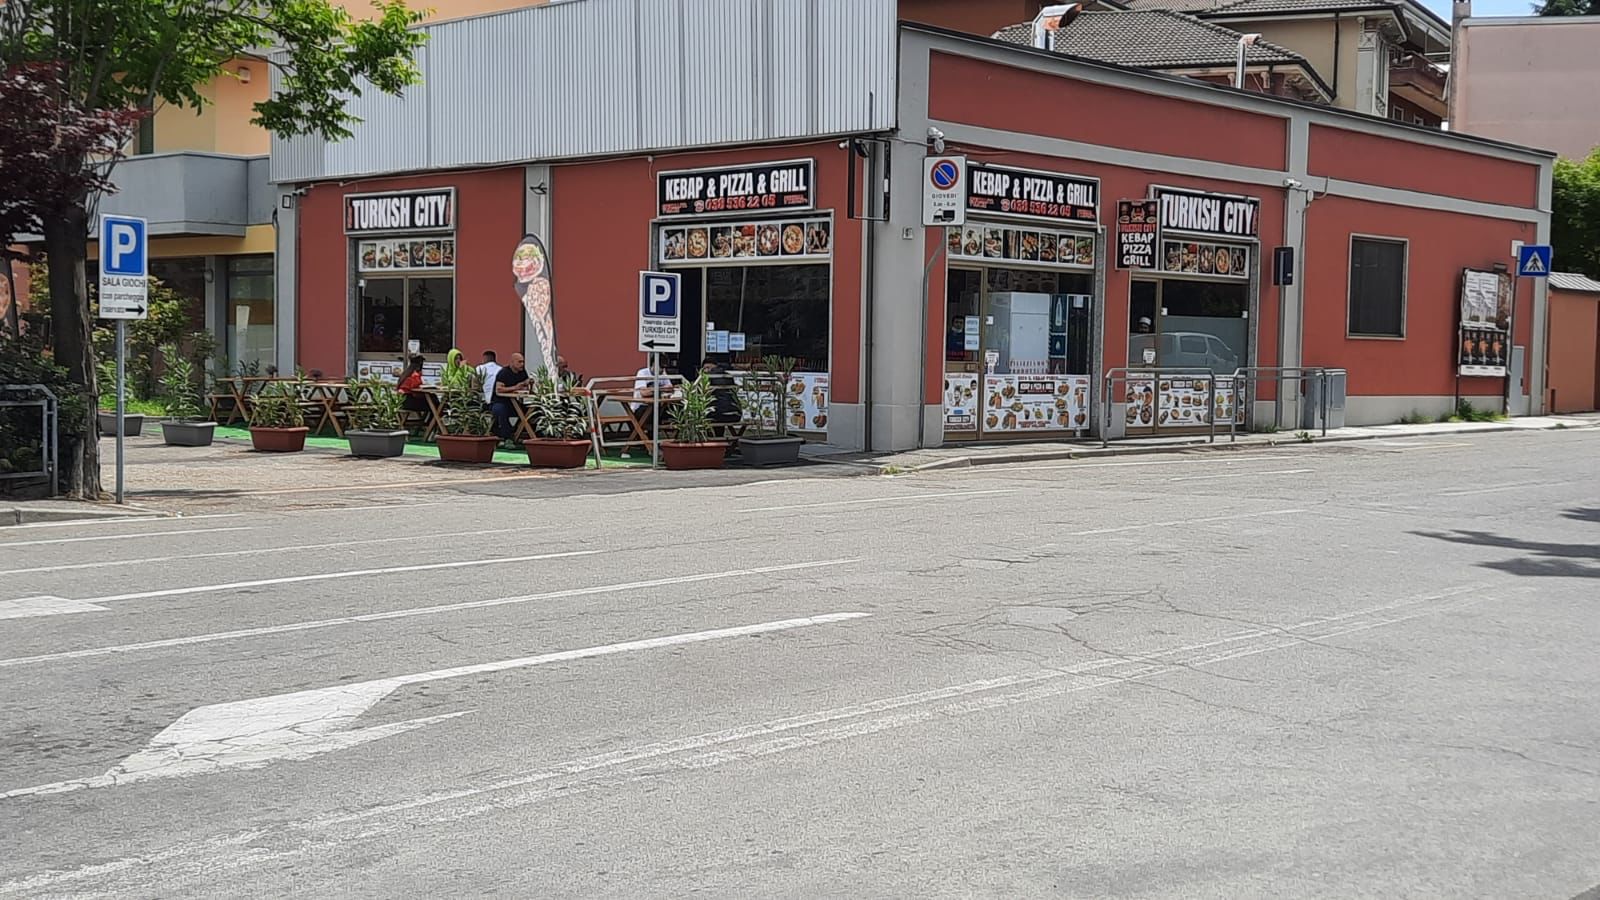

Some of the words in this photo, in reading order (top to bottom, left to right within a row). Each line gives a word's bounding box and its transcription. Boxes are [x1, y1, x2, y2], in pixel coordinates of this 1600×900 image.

[665, 176, 704, 201] KEBAP
[706, 177, 716, 198] &
[719, 172, 753, 196] PIZZA
[757, 173, 766, 194] &
[770, 167, 807, 193] GRILL
[973, 170, 1010, 198] KEBAP
[1012, 178, 1021, 199] &
[1023, 177, 1054, 202] PIZZA
[1056, 183, 1064, 204] &
[1066, 182, 1095, 208] GRILL
[746, 195, 760, 208] 22
[761, 193, 776, 207] 05
[352, 197, 411, 230] TURKISH
[414, 194, 447, 227] CITY
[1047, 203, 1059, 216] 22
[1161, 193, 1221, 232] TURKISH
[1223, 201, 1254, 235] CITY
[1121, 232, 1154, 244] KEBAP
[111, 223, 137, 269] P
[1122, 243, 1152, 255] PIZZA
[1122, 254, 1151, 266] GRILL
[102, 277, 120, 286] SALA
[122, 278, 146, 288] GIOCHI
[649, 278, 671, 313] P
[642, 325, 666, 333] TURKISH
[666, 327, 679, 335] CITY
